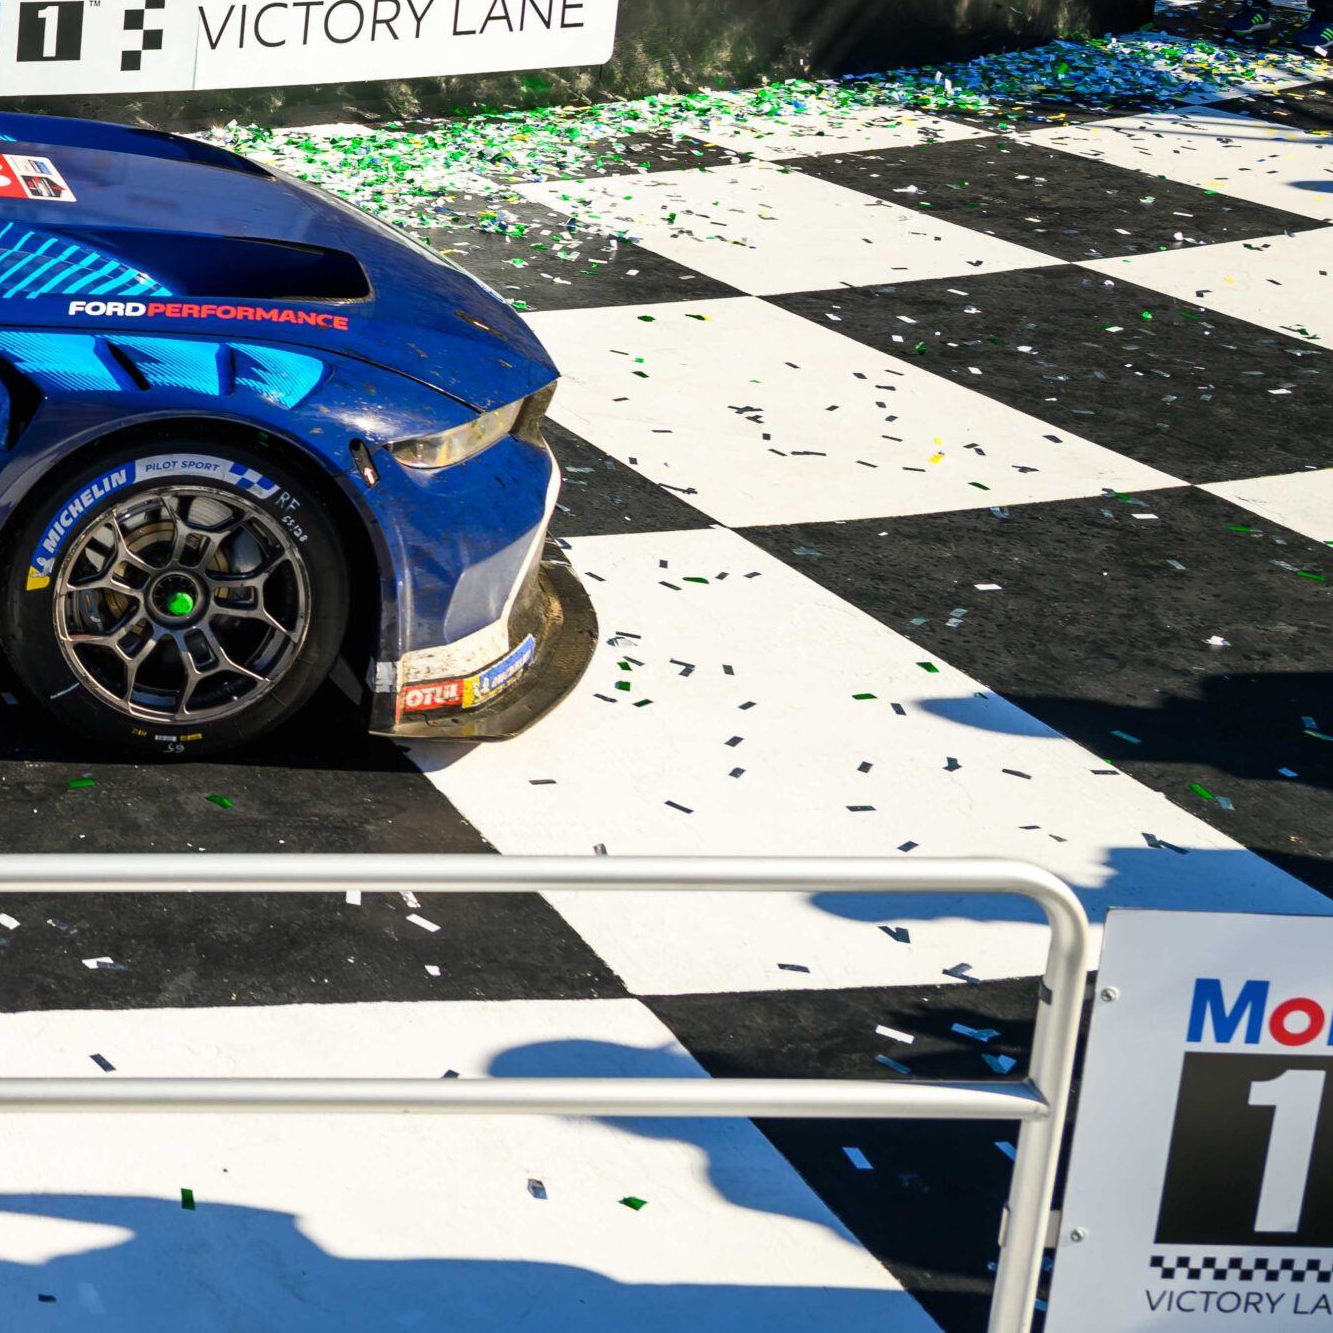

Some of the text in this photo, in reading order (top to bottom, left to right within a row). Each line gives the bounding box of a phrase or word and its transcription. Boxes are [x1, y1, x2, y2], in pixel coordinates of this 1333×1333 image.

[37, 5, 62, 57] 1
[145, 460, 220, 472] PILOT SPORT
[42, 468, 127, 554] MICHELIN
[275, 492, 301, 512] RF
[1248, 1069, 1326, 1233] 1
[1146, 1289, 1285, 1313] VICTORY
